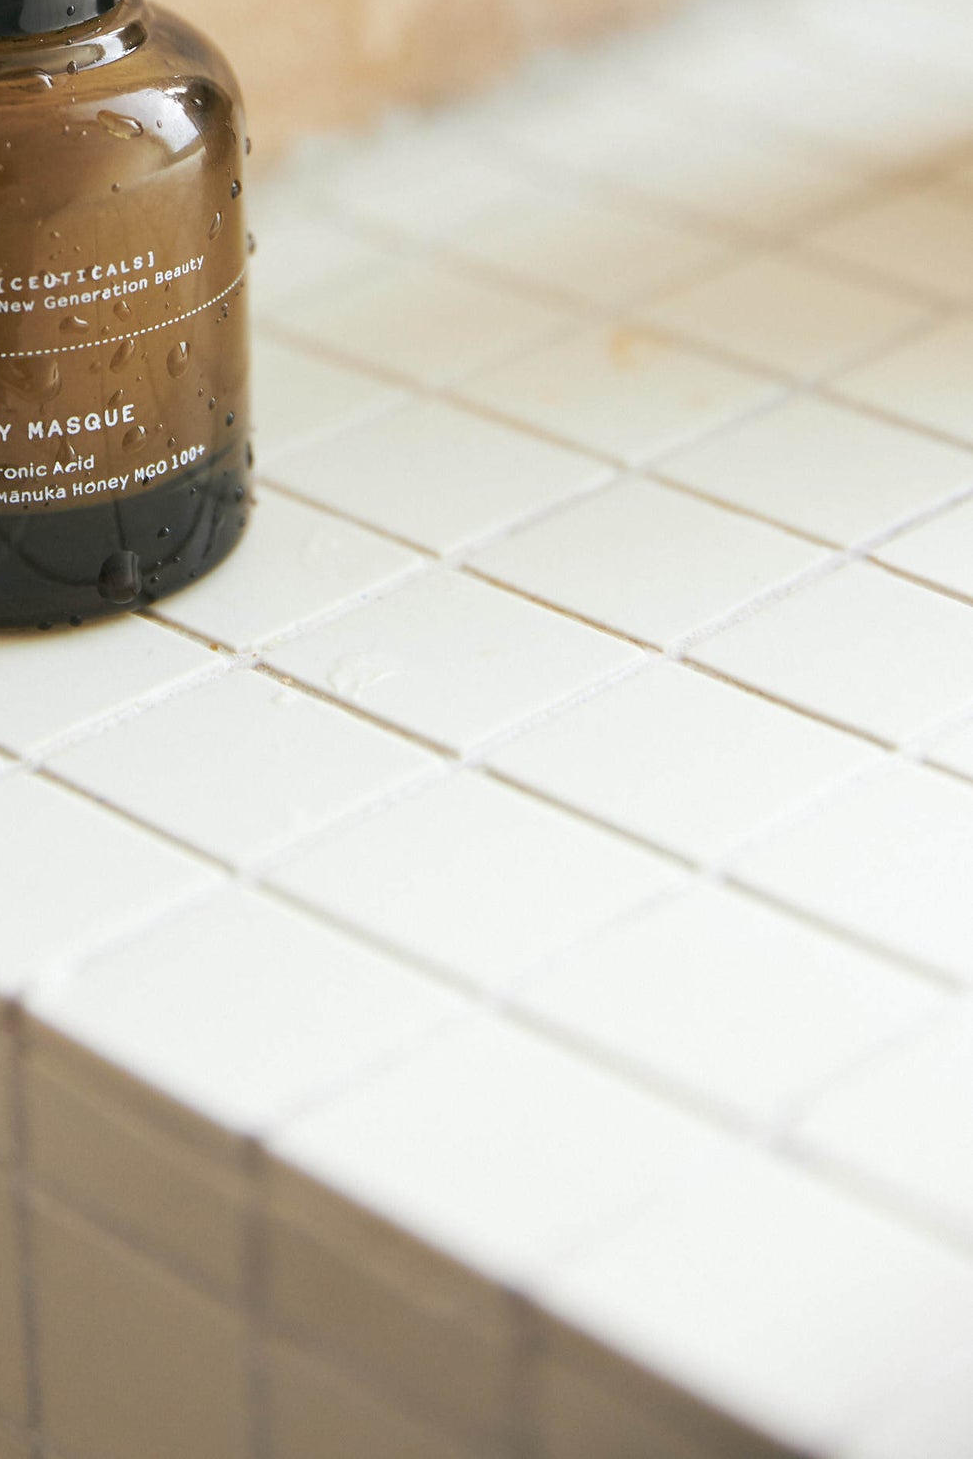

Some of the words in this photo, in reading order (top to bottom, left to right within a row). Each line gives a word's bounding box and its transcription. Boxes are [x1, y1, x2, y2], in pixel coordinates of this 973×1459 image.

[44, 281, 148, 310] Generation
[154, 255, 204, 285] Beauty
[28, 404, 135, 440] MASQUE
[53, 455, 94, 474] Acid
[72, 473, 129, 497] Honey
[134, 462, 167, 483] MGO
[171, 444, 206, 470] 100+
